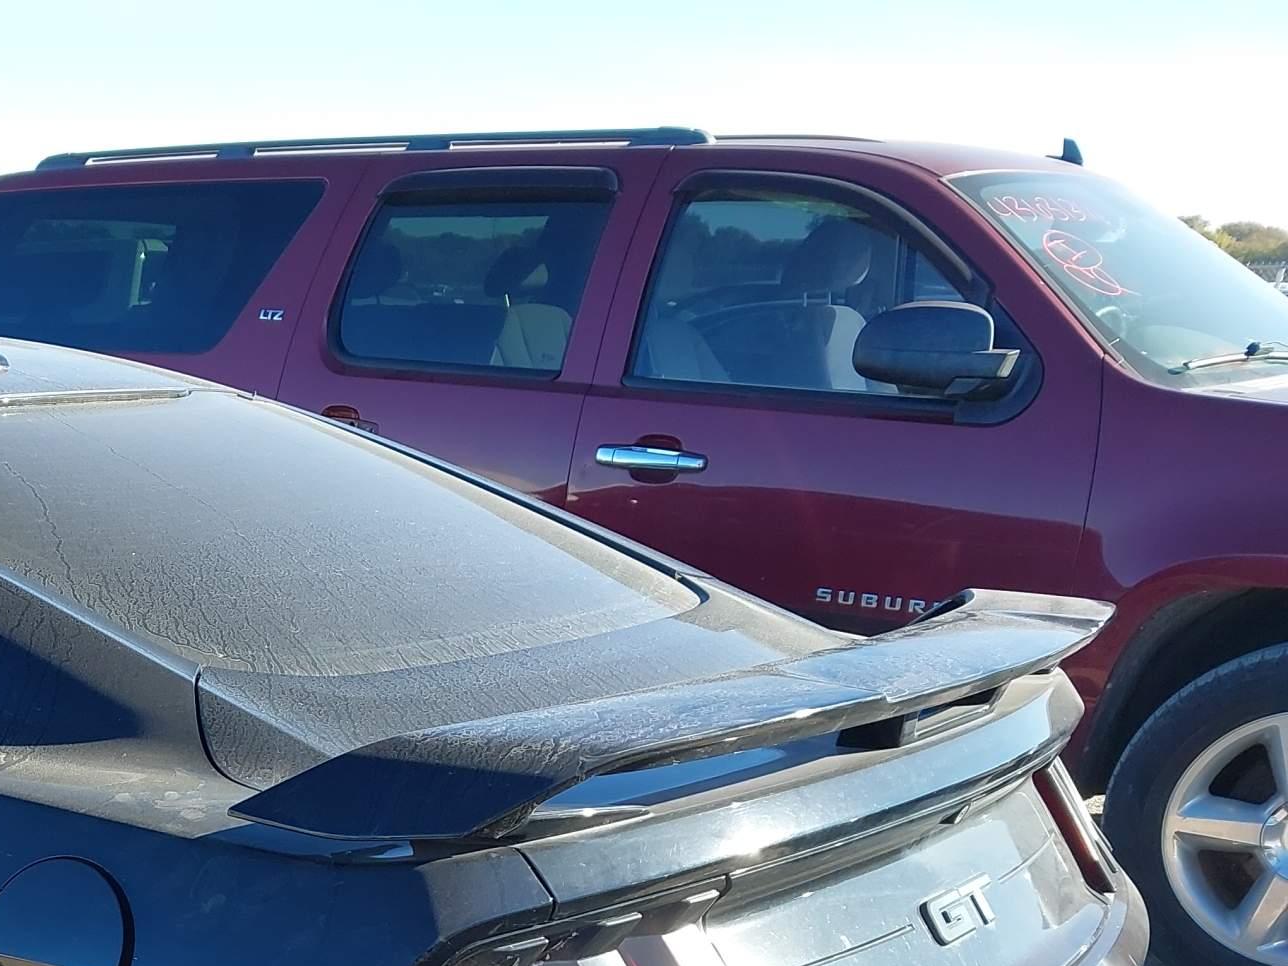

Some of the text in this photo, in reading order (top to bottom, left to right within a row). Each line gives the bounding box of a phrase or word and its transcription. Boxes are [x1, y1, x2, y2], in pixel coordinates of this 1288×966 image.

[259, 309, 285, 321] LTZ
[815, 587, 942, 614] SUBUR
[919, 871, 996, 947] GT
